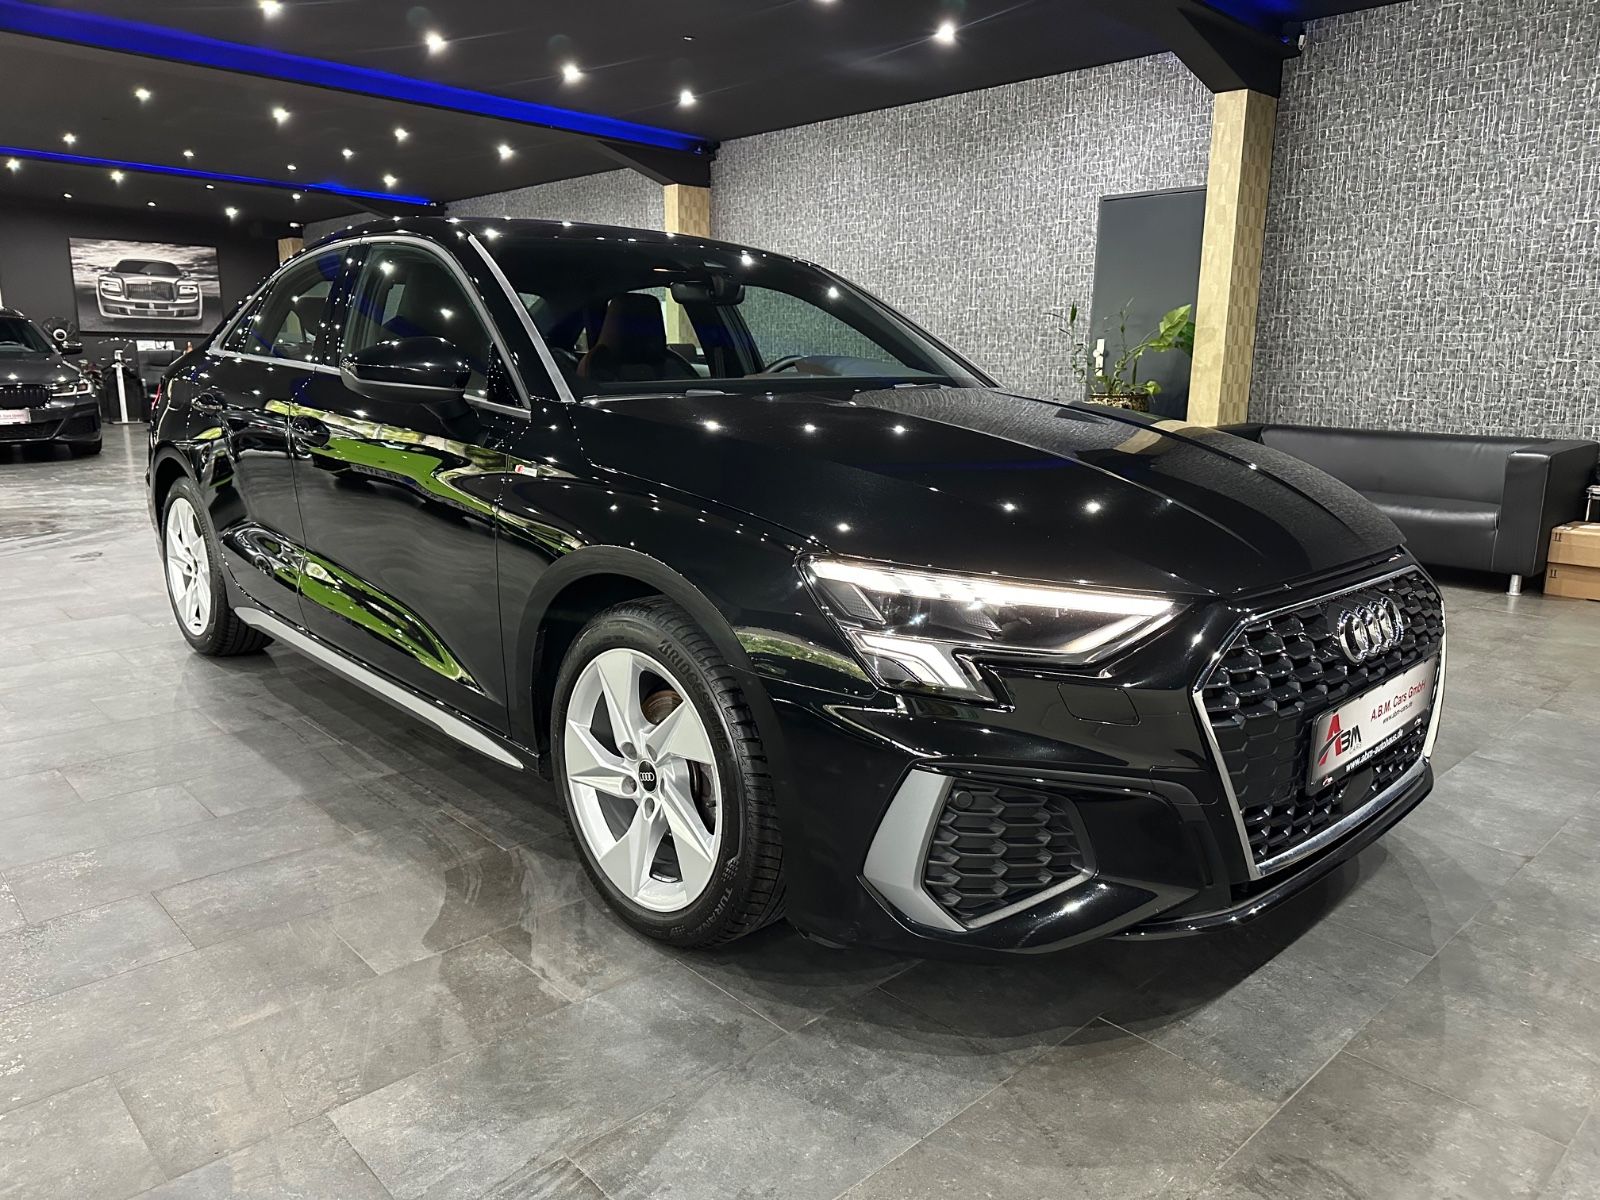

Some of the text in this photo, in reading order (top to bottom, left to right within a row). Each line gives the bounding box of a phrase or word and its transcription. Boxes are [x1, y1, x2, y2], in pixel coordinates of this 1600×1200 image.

[1371, 700, 1392, 722] A.B.M.
[1393, 692, 1407, 708] Cars
[1408, 679, 1426, 699] GmbH
[1318, 713, 1362, 766] ABM
